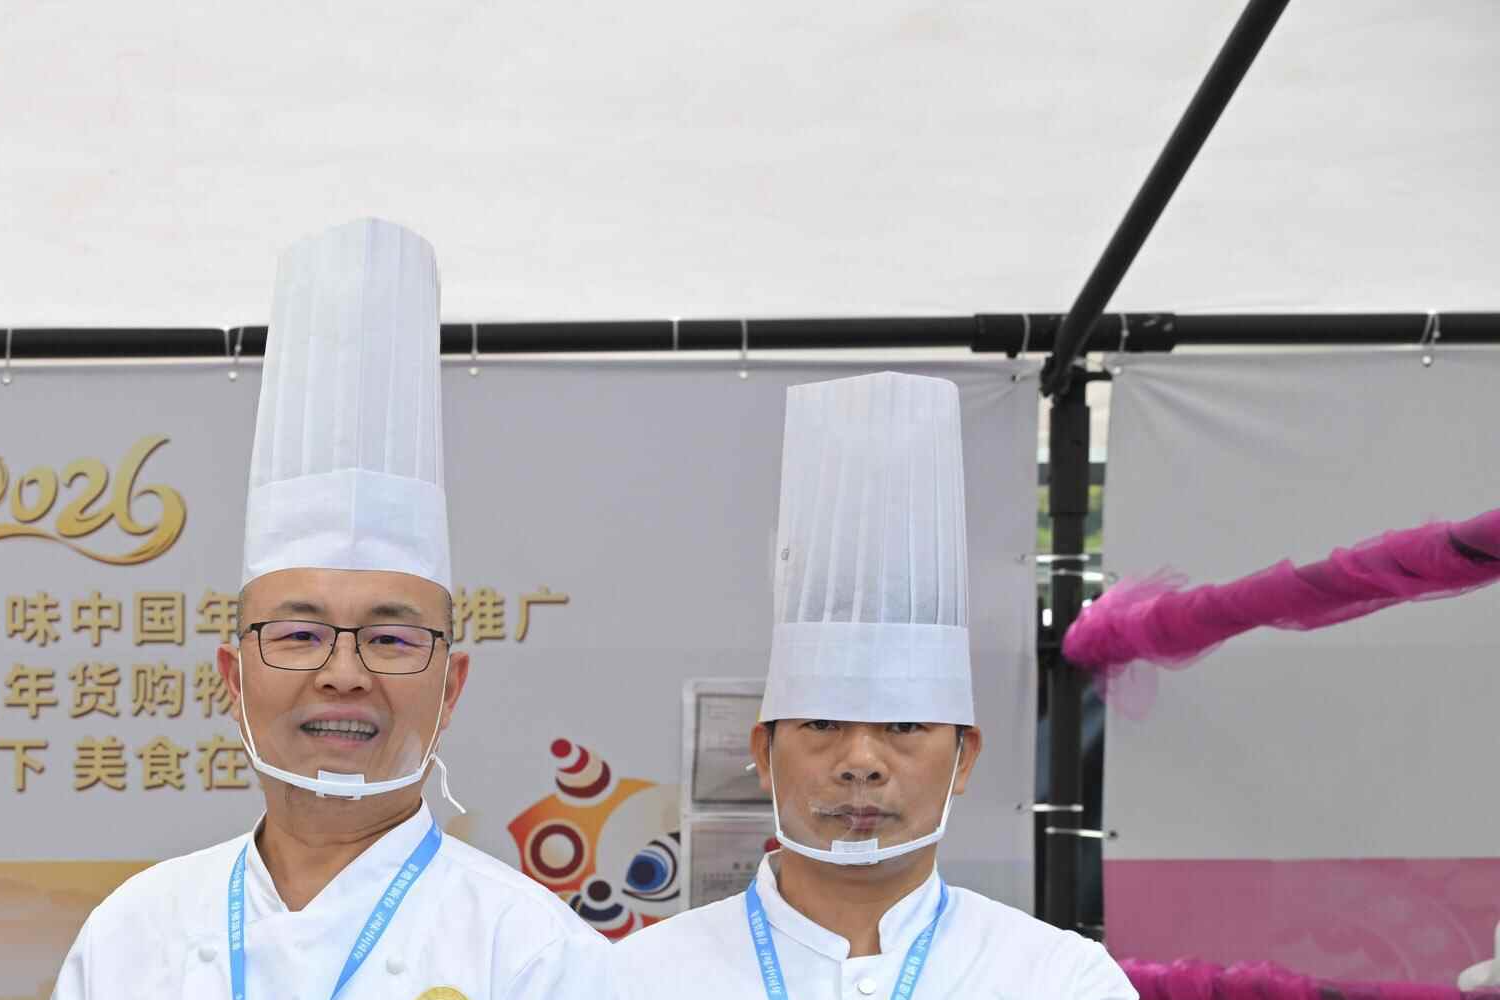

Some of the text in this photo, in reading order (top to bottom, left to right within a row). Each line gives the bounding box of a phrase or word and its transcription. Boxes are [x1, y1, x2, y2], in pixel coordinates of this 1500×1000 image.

[452, 586, 569, 643] 推广
[72, 736, 250, 793] 美食在
